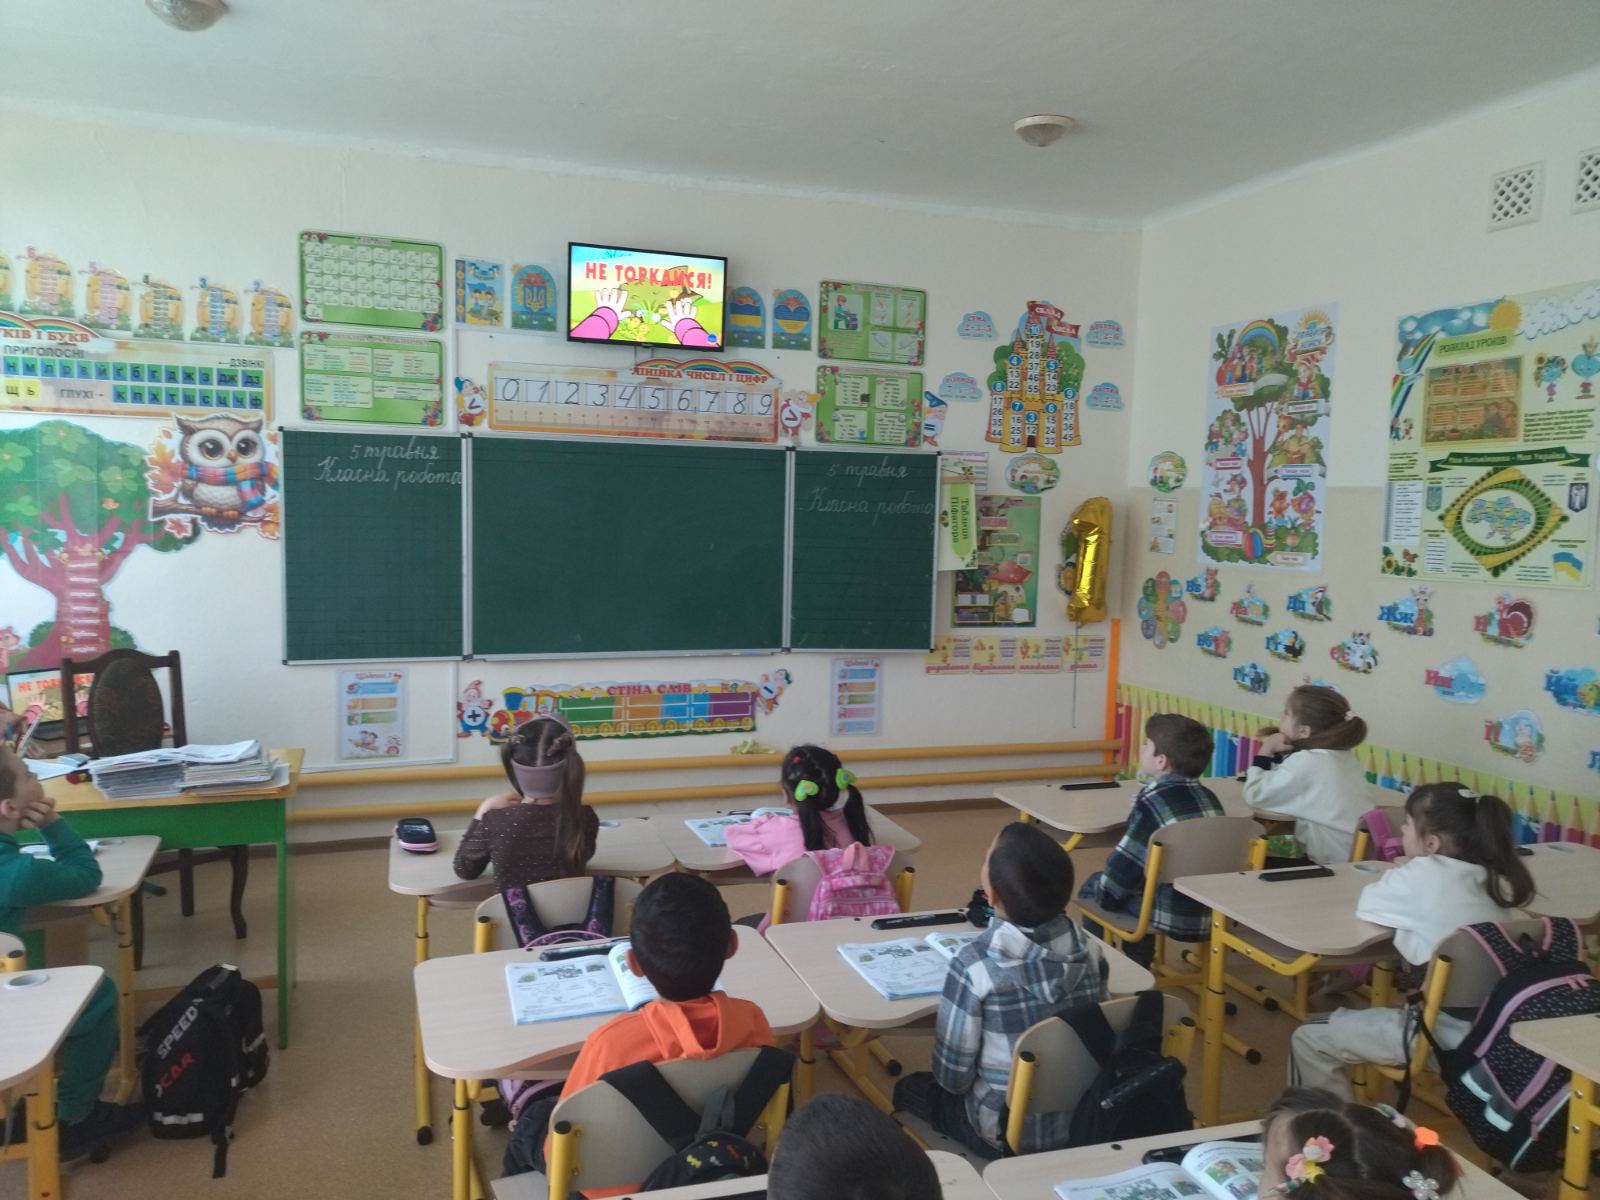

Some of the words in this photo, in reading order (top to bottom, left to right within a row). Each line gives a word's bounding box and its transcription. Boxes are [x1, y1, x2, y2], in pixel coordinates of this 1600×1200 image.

[586, 262, 608, 280] НЕ
[200, 277, 208, 288] 3
[254, 280, 260, 292] 2
[48, 332, 90, 343] БУКВ
[1030, 340, 1040, 348] 19
[4, 345, 85, 358] ПРИГОЛОСНІ
[1029, 352, 1040, 360] 28
[1012, 356, 1018, 364] 4
[1028, 362, 1040, 370] 37
[1050, 362, 1056, 370] 5
[632, 367, 682, 378] ЛІНІЙКА
[686, 371, 726, 382] ЧИСЕЛ
[736, 374, 768, 384] ЦИФР
[1009, 370, 1020, 378] 13
[1028, 374, 1040, 382] 46
[1047, 372, 1058, 381] 14
[996, 383, 1002, 391] 8
[1008, 380, 1020, 389] 22
[1028, 385, 1040, 393] 55
[1046, 384, 1058, 392] 23
[502, 379, 520, 401] 0
[539, 380, 550, 402] 1
[564, 382, 580, 404] 2
[592, 384, 608, 406] 3
[617, 386, 638, 408] 4
[649, 387, 664, 410] 5
[678, 390, 694, 411] 6
[705, 390, 721, 414] 7
[732, 392, 748, 415] 8
[758, 394, 772, 416] 9
[1066, 390, 1073, 398] 9
[1014, 402, 1021, 411] 7
[1048, 404, 1055, 412] 6
[1065, 402, 1074, 410] 18
[1011, 416, 1022, 424] 16
[1028, 413, 1035, 422] 3
[1046, 416, 1056, 424] 15
[1064, 412, 1074, 420] 27
[1010, 427, 1022, 435] 25
[1026, 426, 1037, 434] 12
[1046, 426, 1056, 435] 24
[1010, 437, 1022, 445] 34
[1045, 437, 1056, 446] 33
[350, 445, 362, 460] 5
[364, 436, 440, 470] травня
[314, 456, 390, 482] Класна
[827, 464, 840, 476] 5
[806, 488, 869, 513] Класна
[1378, 606, 1415, 624] Жж
[608, 684, 652, 696] СТІНА
[158, 1006, 199, 1060] SPEED
[160, 1052, 194, 1088] CAR
